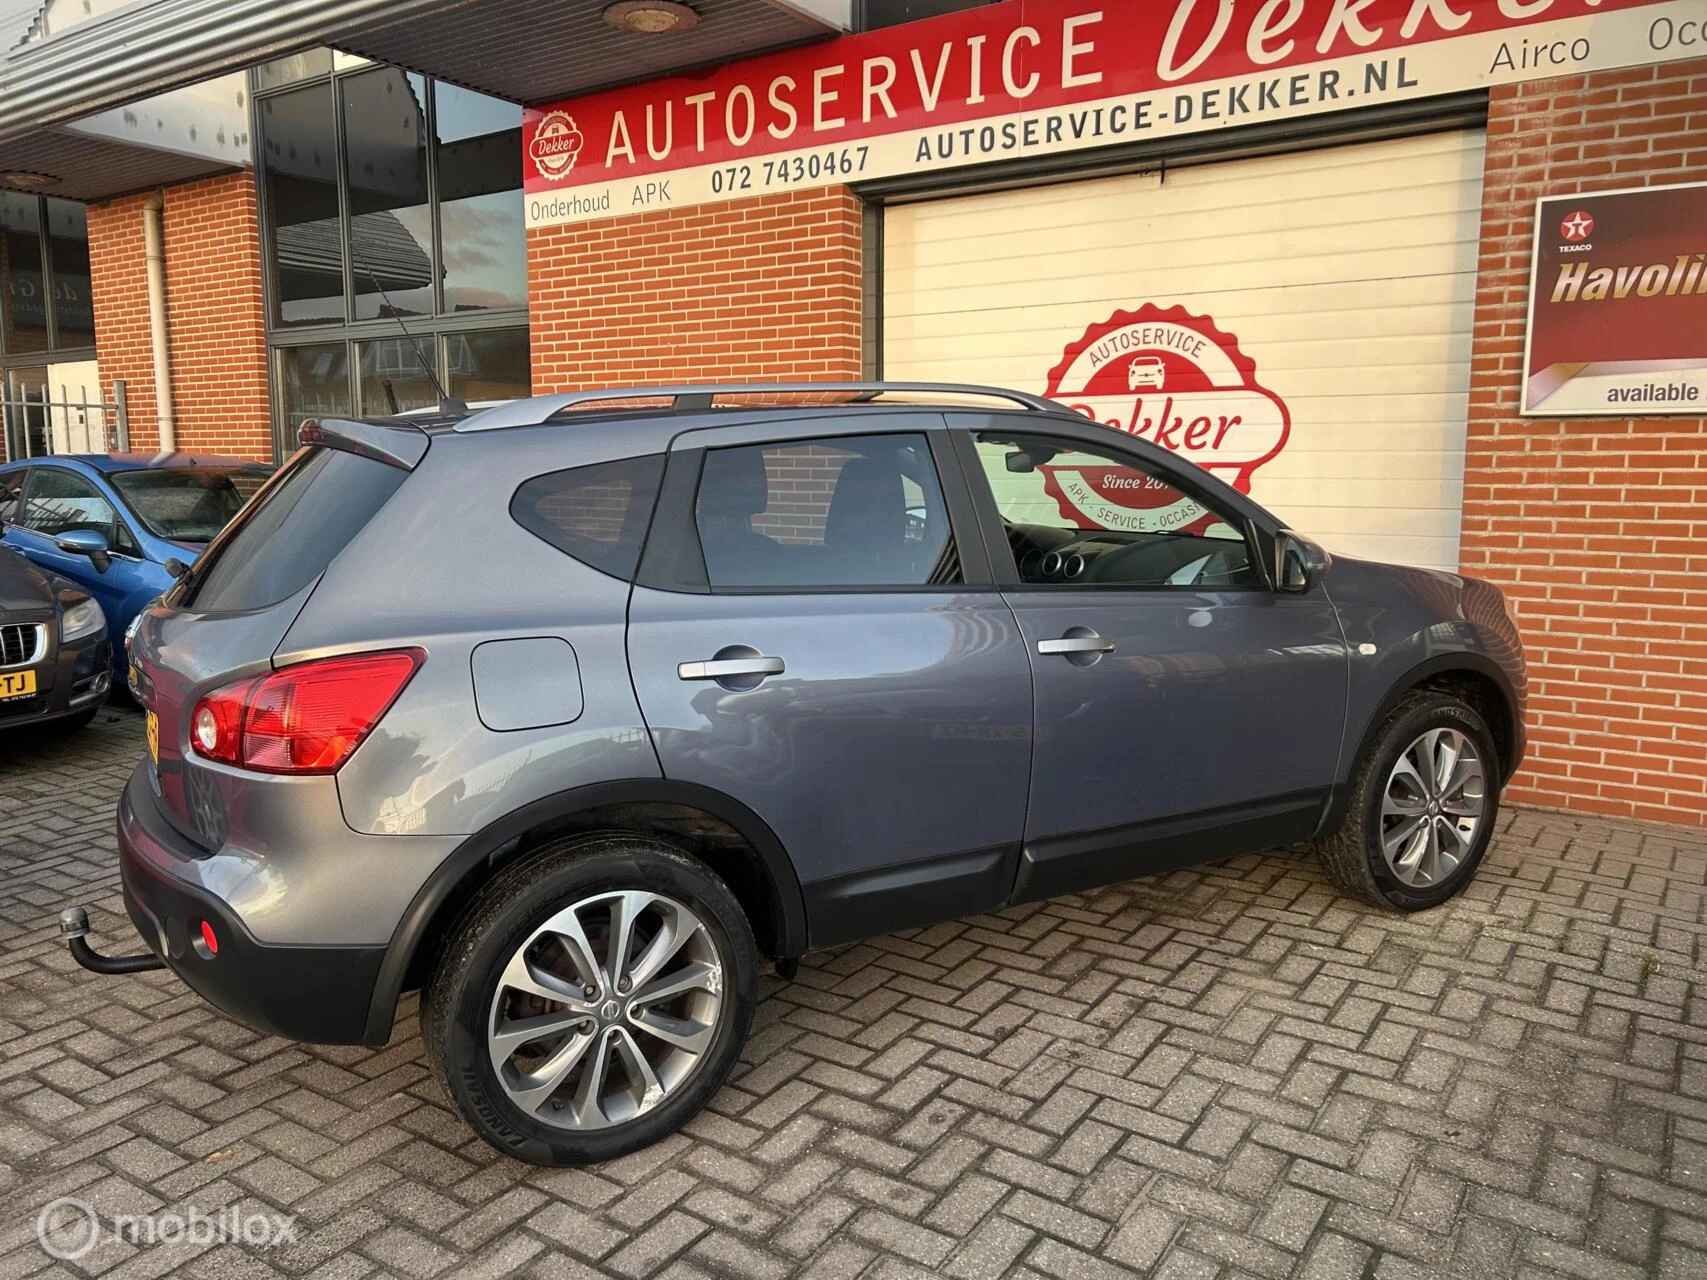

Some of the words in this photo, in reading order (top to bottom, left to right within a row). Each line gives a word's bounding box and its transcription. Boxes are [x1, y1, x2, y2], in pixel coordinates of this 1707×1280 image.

[1648, 17, 1707, 50] Oc
[1489, 38, 1591, 74] Airco
[604, 10, 1103, 169] AUTOSERVICE
[914, 57, 1418, 163] AUTOSERVICE-DEKKER.NL
[538, 135, 575, 155] Dekker
[711, 165, 751, 194] 072
[763, 146, 869, 187] 7430467
[531, 189, 610, 221] Onderhoud
[632, 179, 671, 206] APK
[1559, 243, 1593, 253] TEXACO
[1089, 328, 1206, 368] AUTOSERVICE
[1607, 382, 1699, 402] available
[1102, 474, 1140, 489] Since
[1067, 482, 1089, 505] APK
[1097, 507, 1146, 530] SERVICE
[461, 1062, 529, 1148] LANDSAIL
